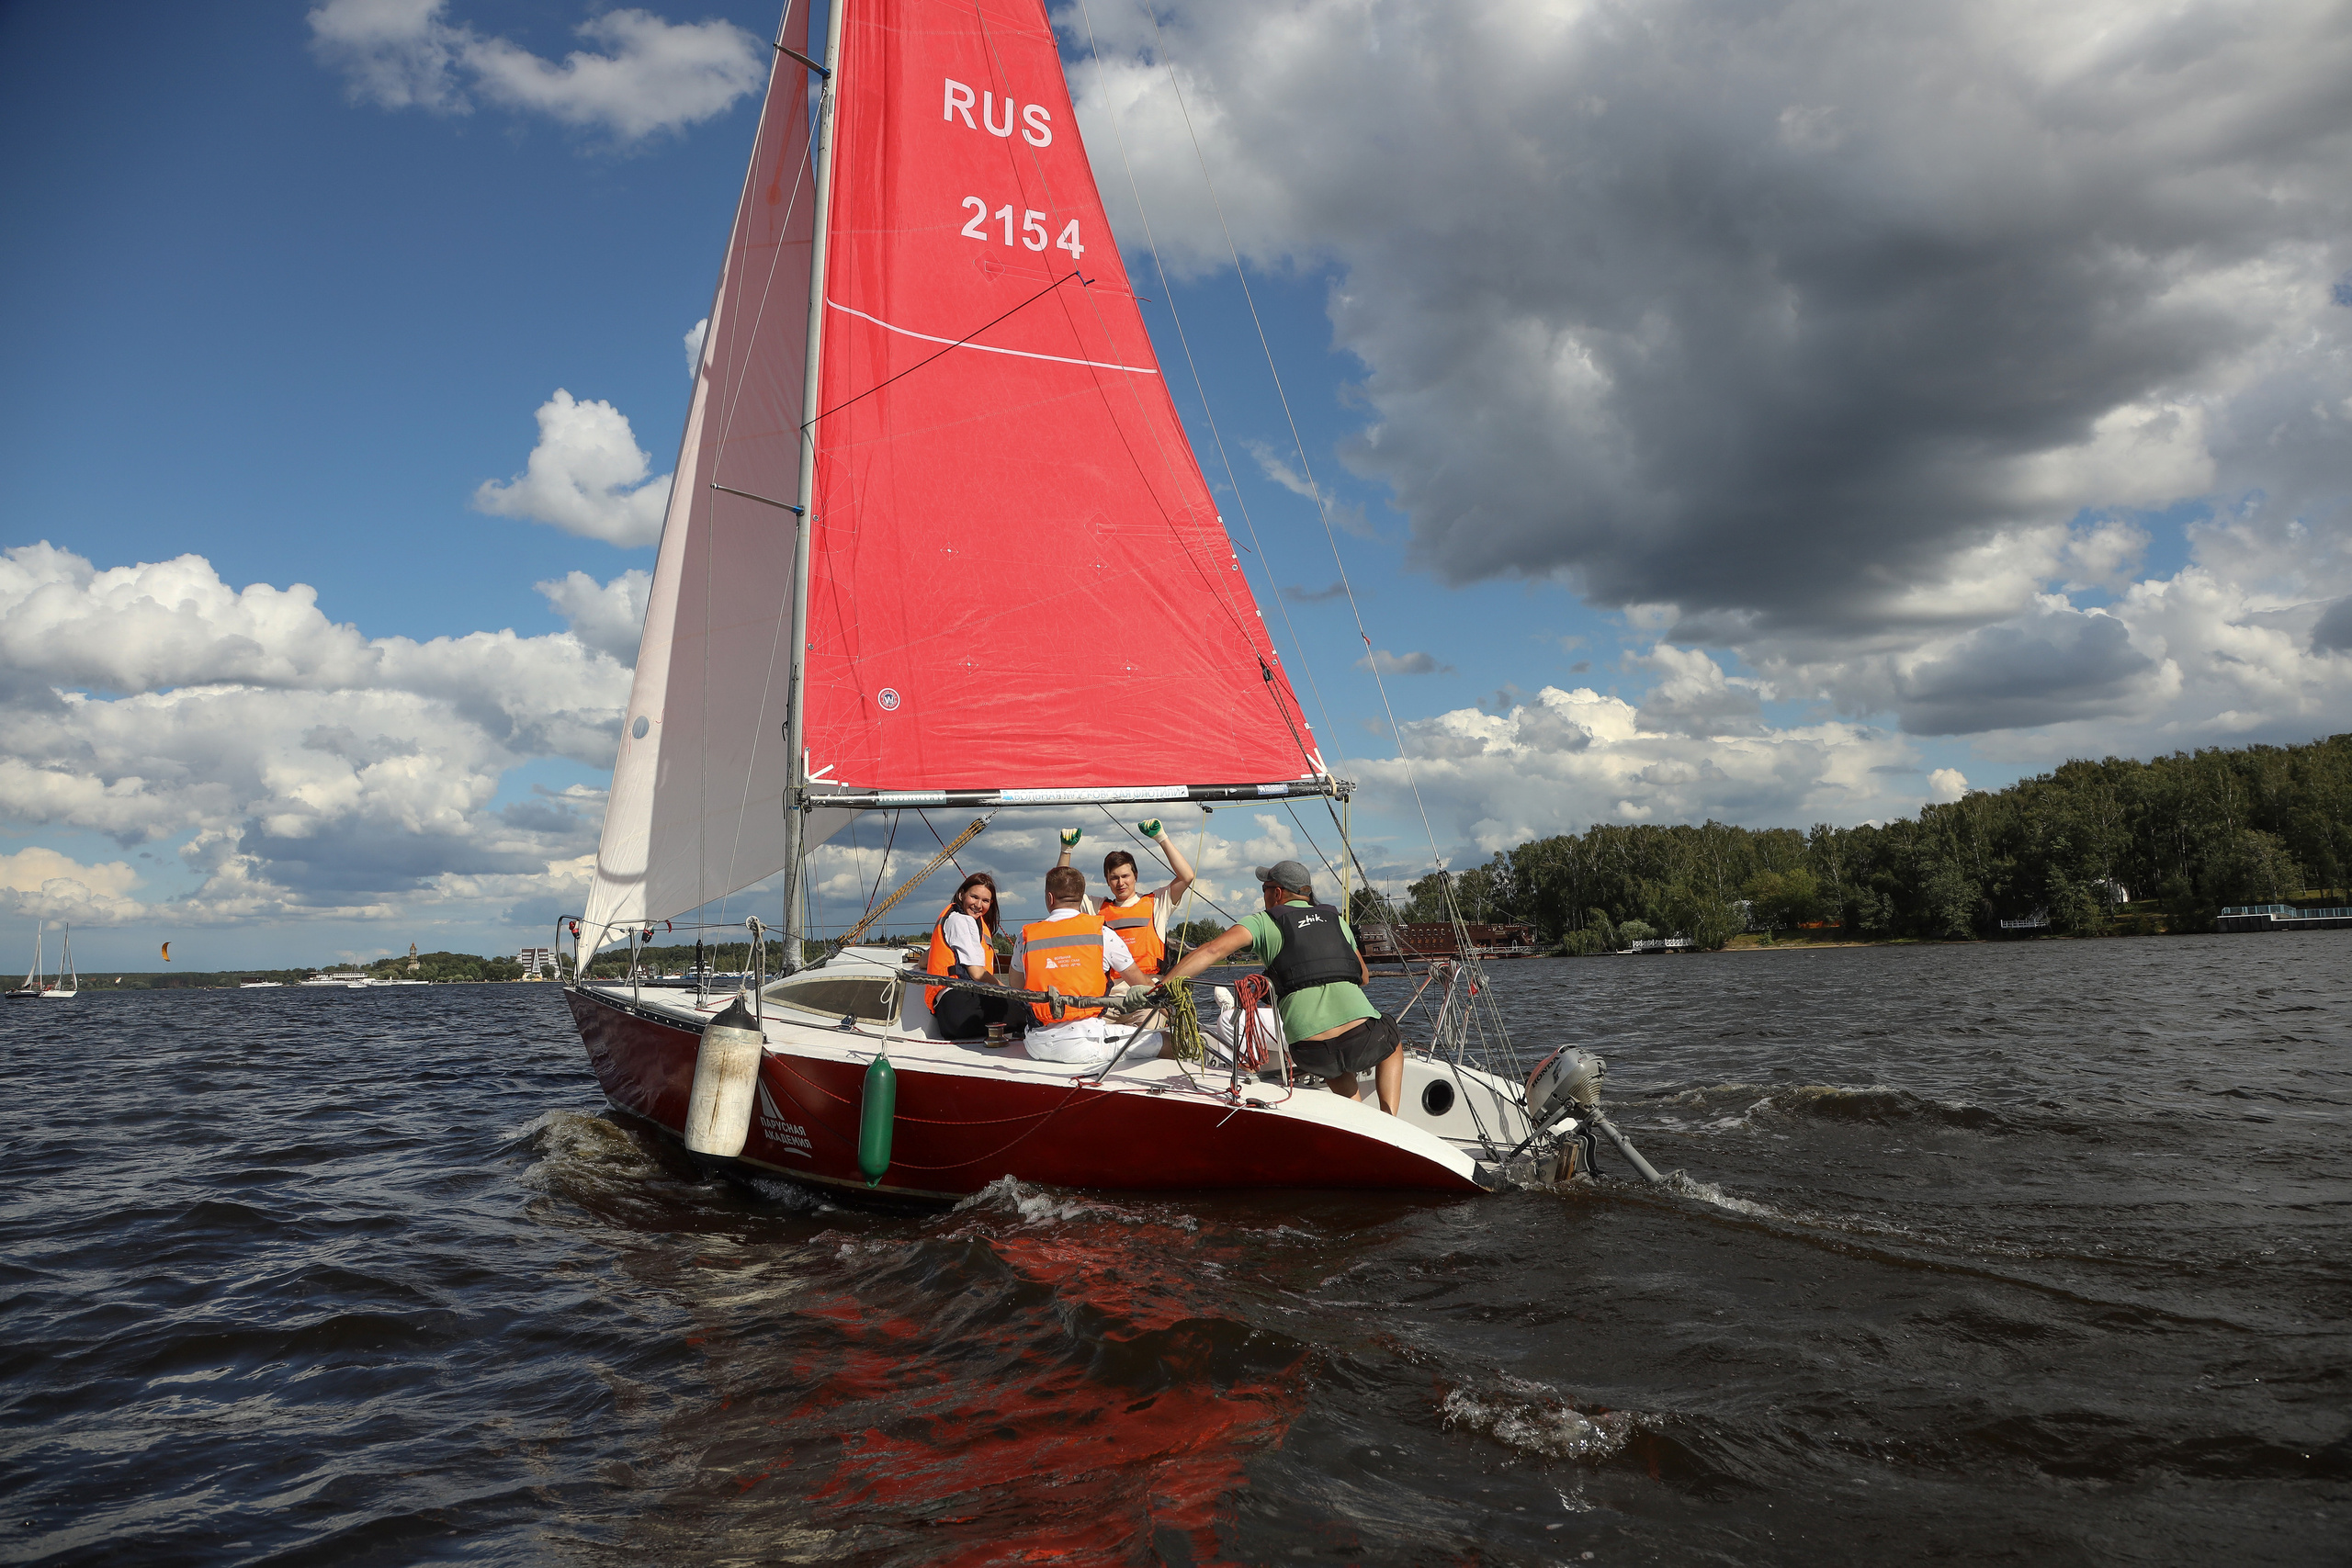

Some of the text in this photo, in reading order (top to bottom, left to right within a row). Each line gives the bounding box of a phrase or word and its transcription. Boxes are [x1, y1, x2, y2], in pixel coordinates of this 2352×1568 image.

[944, 77, 1053, 148] RUS
[961, 196, 1085, 259] 2154
[1014, 791, 1061, 802] ВОЛЬНАЯ
[1532, 1056, 1560, 1088] HONDA
[760, 1116, 807, 1136] ПАРУСНАЯ
[764, 1129, 812, 1149] АКАДЕМИЯ
